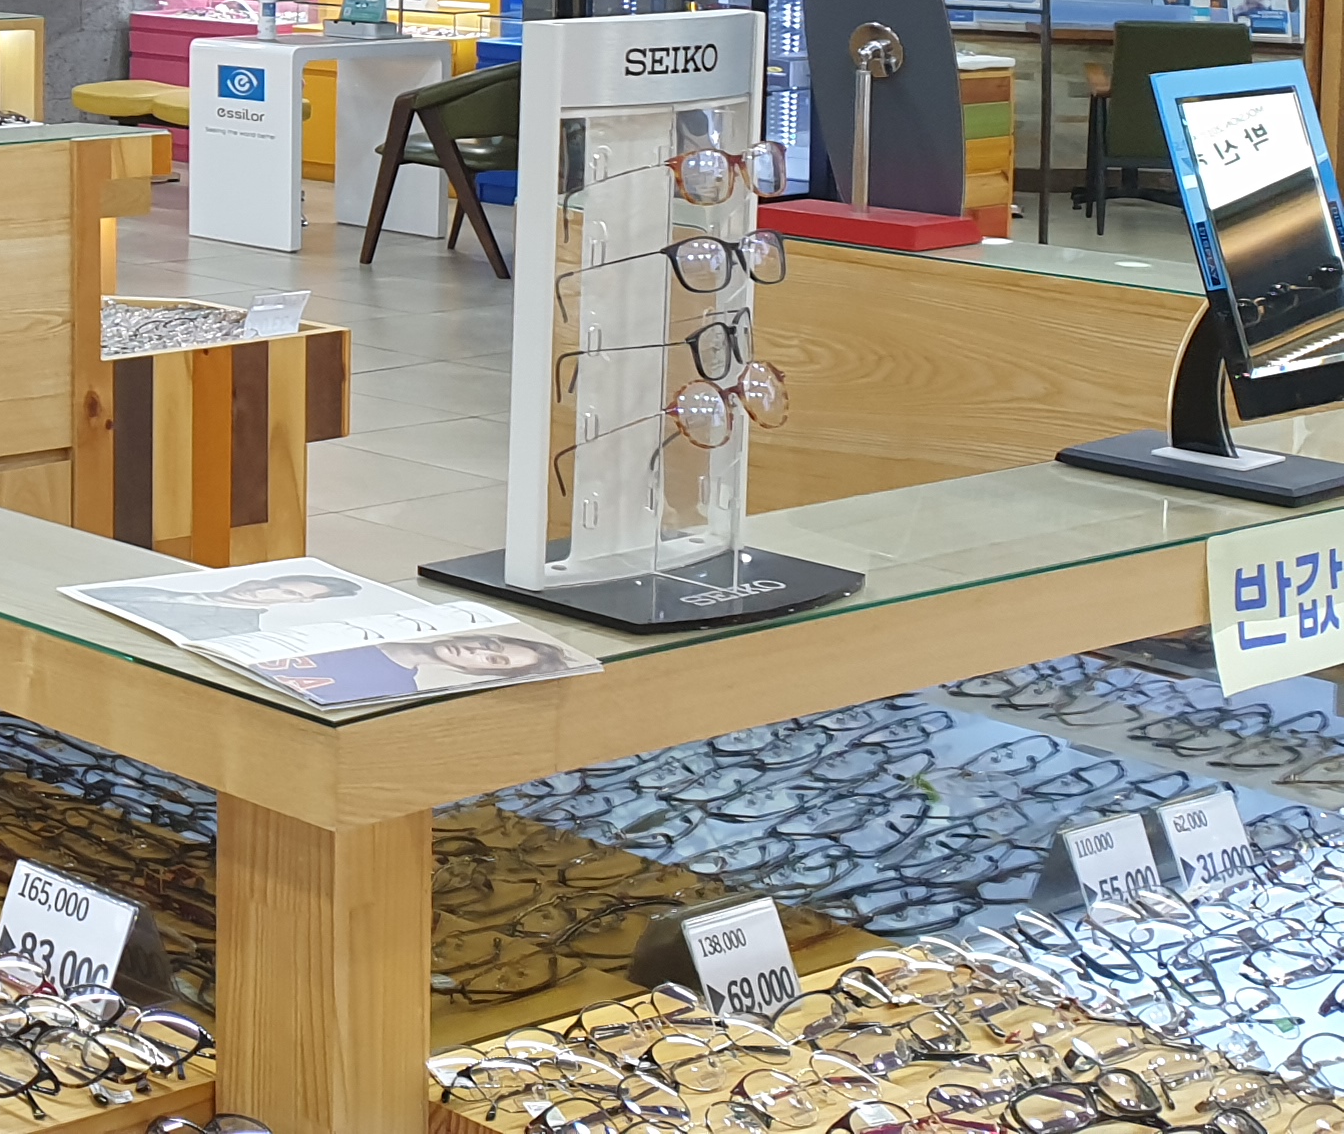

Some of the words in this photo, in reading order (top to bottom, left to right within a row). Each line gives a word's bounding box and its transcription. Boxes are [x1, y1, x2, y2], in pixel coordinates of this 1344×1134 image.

[624, 42, 720, 78] SEIKO
[216, 107, 266, 122] essilor
[679, 579, 787, 606] SEIKO
[1235, 548, 1343, 651] 반값
[1173, 809, 1208, 833] 62,000
[1075, 831, 1114, 858] 110,000
[1196, 844, 1252, 884] 31,000
[18, 872, 90, 922] 165,000
[698, 927, 747, 958] 138,000
[727, 965, 795, 1013] 69,000
